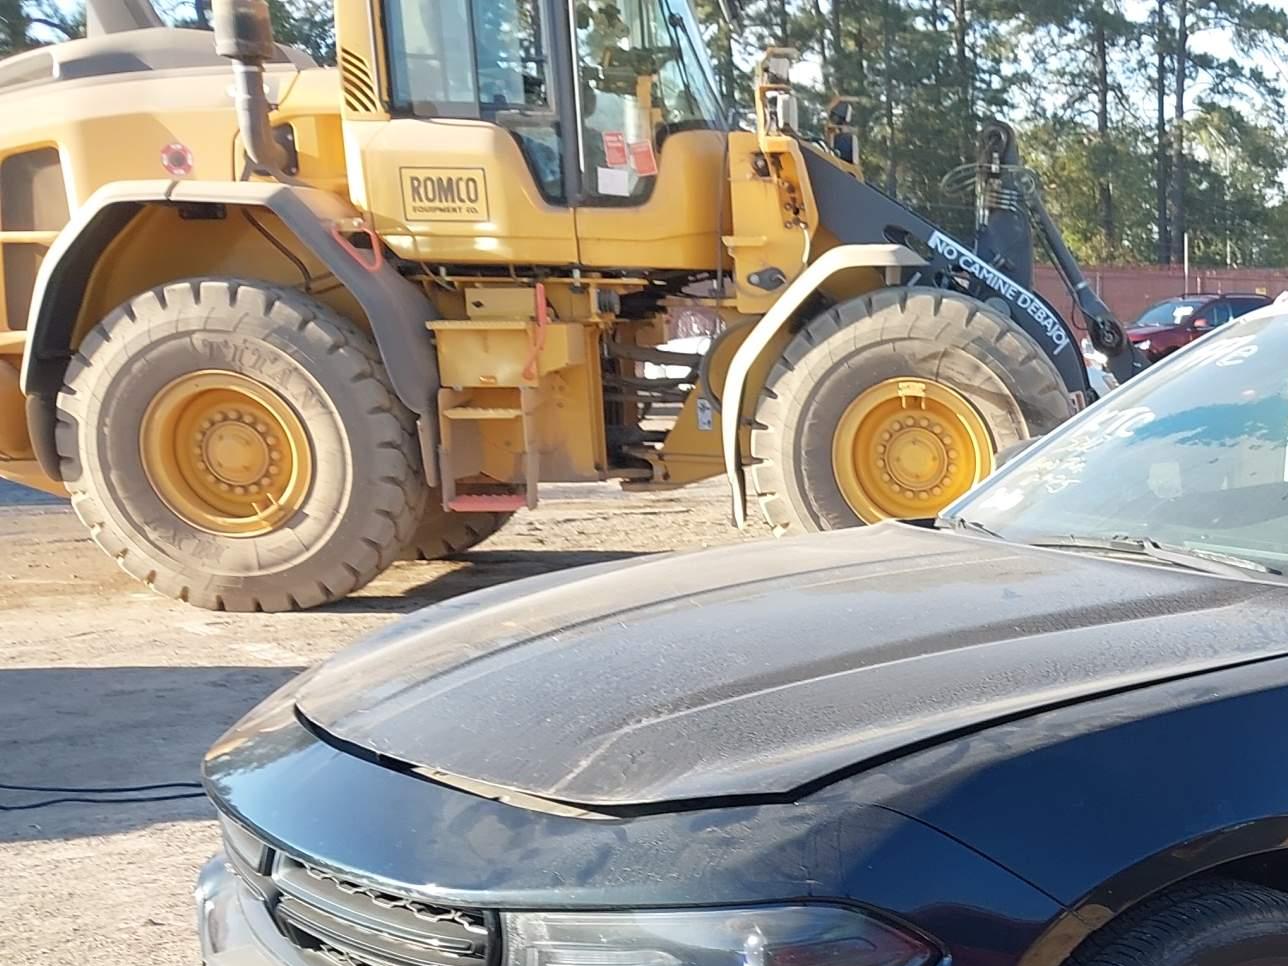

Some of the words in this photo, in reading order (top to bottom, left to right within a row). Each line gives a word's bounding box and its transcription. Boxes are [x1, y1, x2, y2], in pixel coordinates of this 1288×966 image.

[410, 176, 479, 203] ROMCO
[931, 236, 958, 260] NO
[959, 256, 1018, 301] CAMINE
[1016, 292, 1066, 345] DEBAJO
